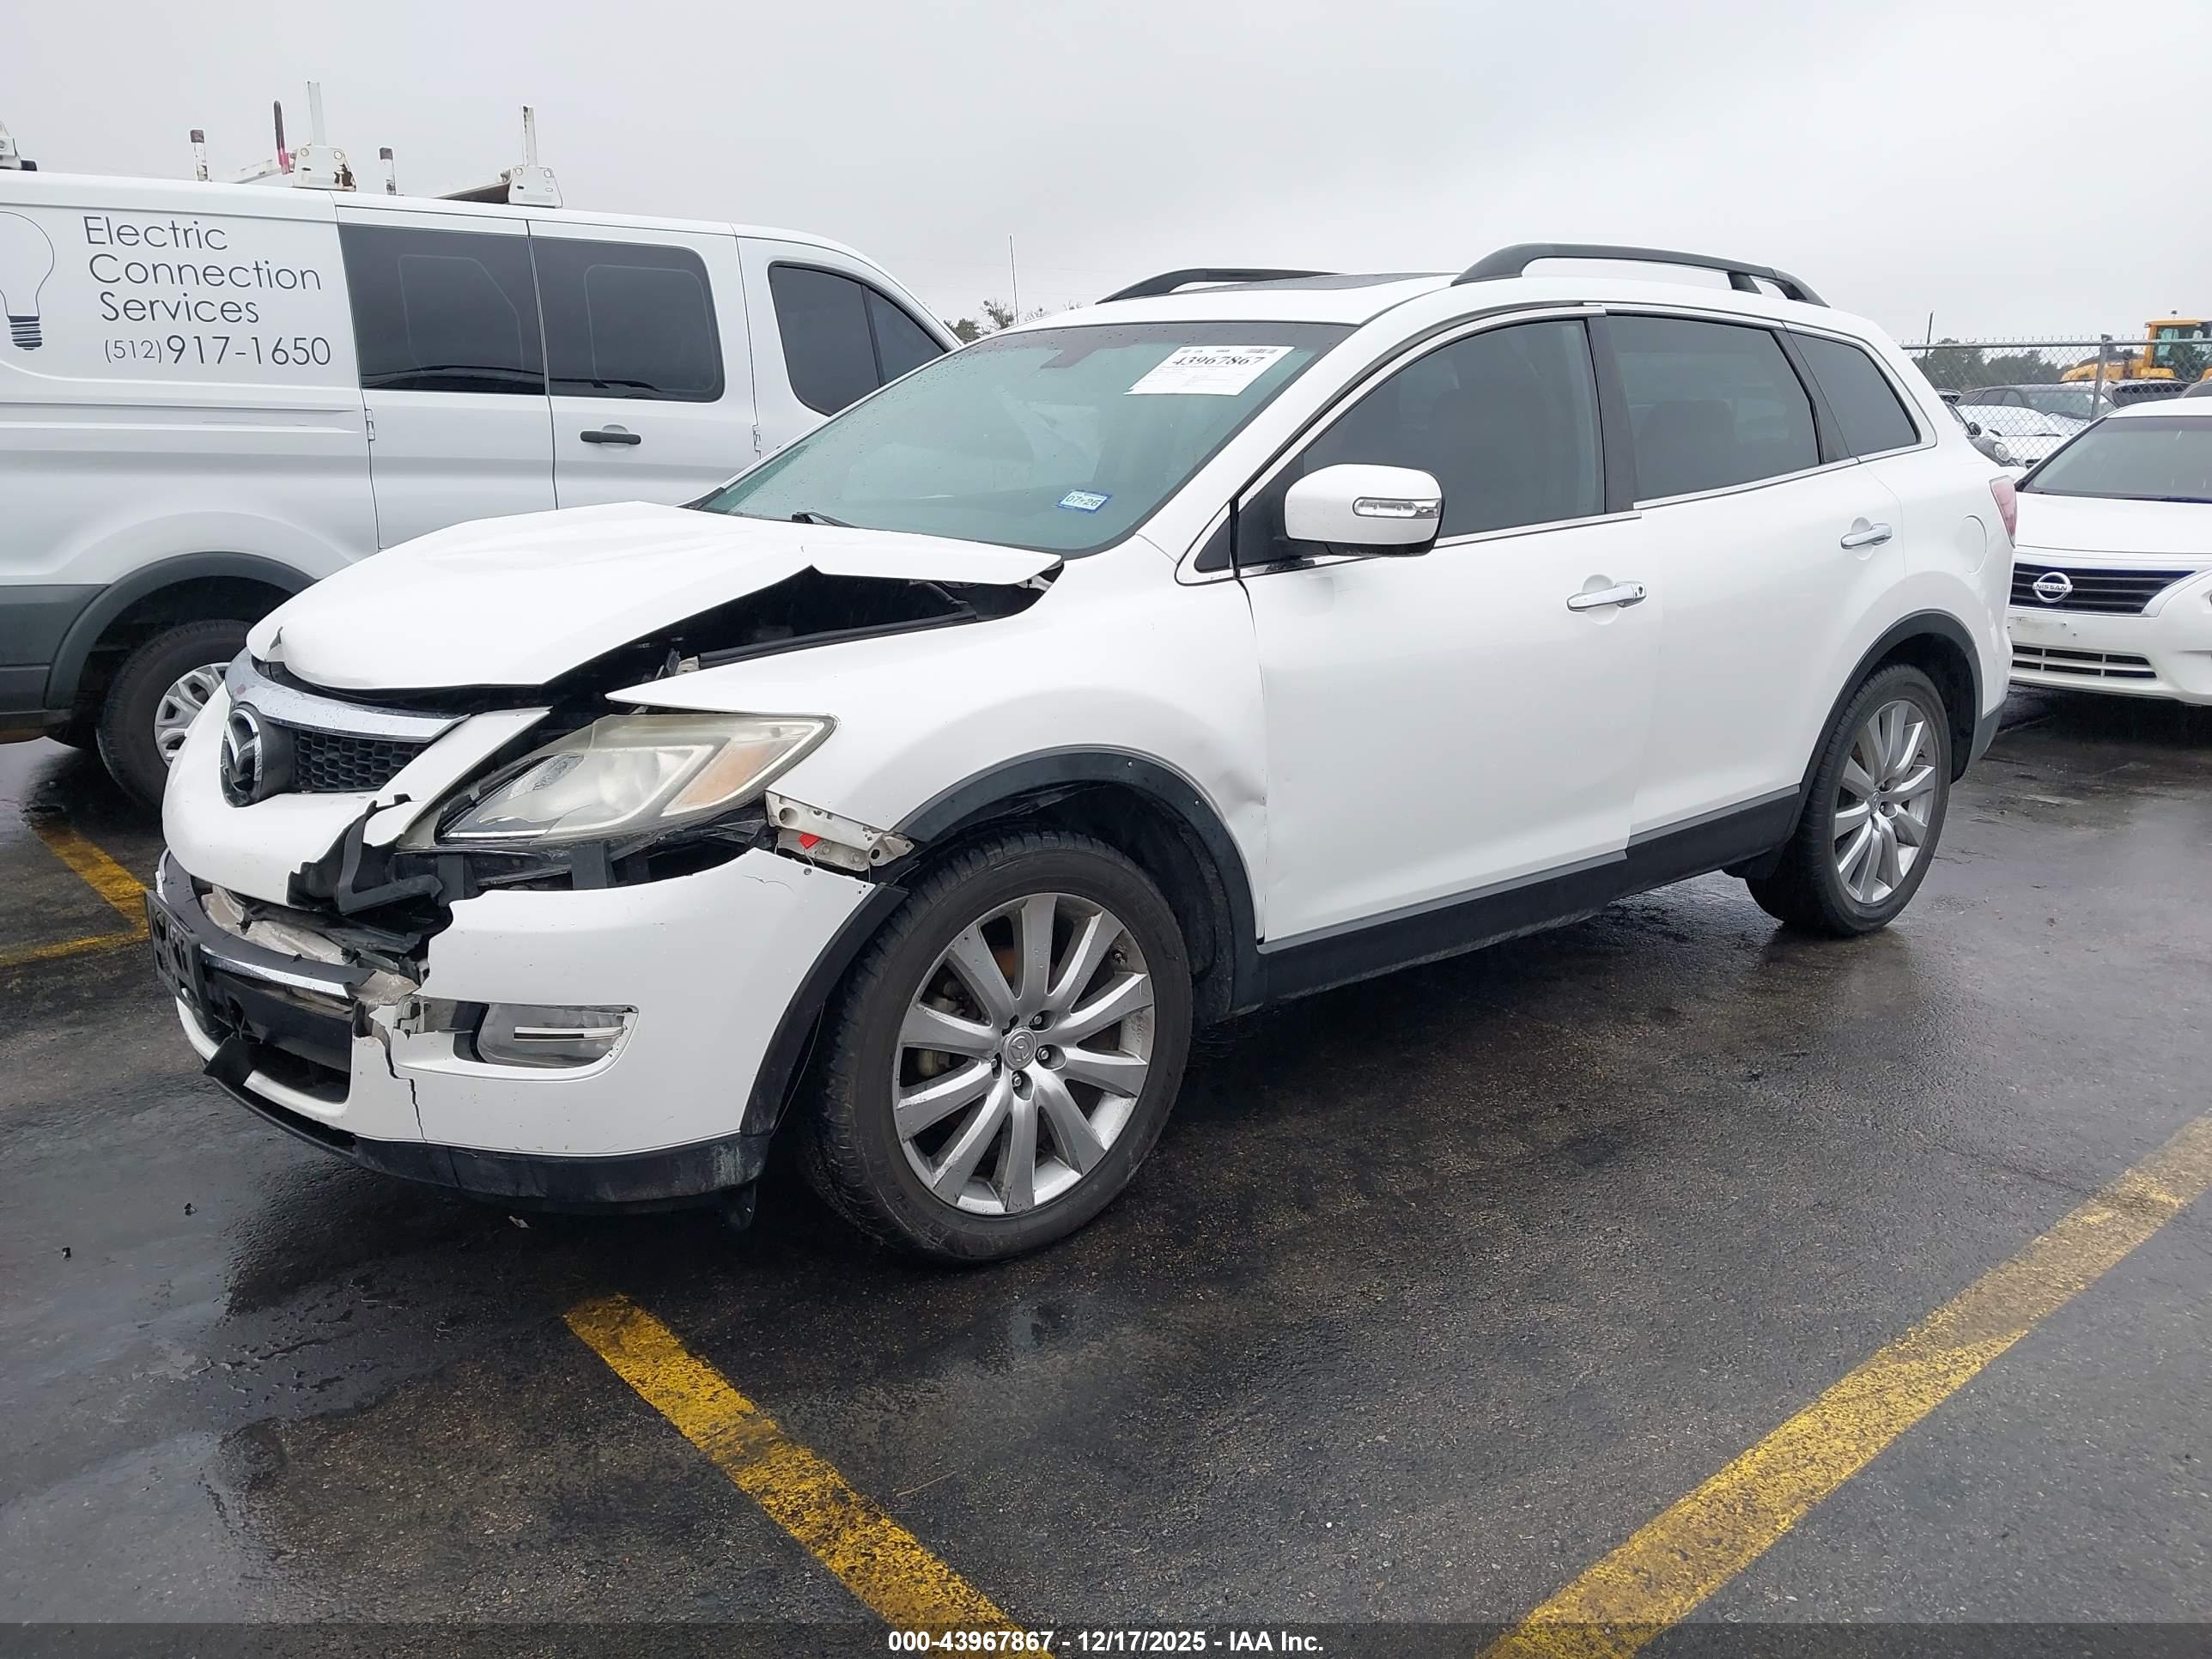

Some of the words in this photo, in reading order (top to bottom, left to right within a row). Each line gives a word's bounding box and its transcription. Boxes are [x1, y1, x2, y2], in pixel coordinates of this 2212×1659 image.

[82, 216, 228, 251] Electric
[88, 253, 322, 291] Connection
[100, 291, 259, 324] Services
[1172, 356, 1267, 366] 43967867
